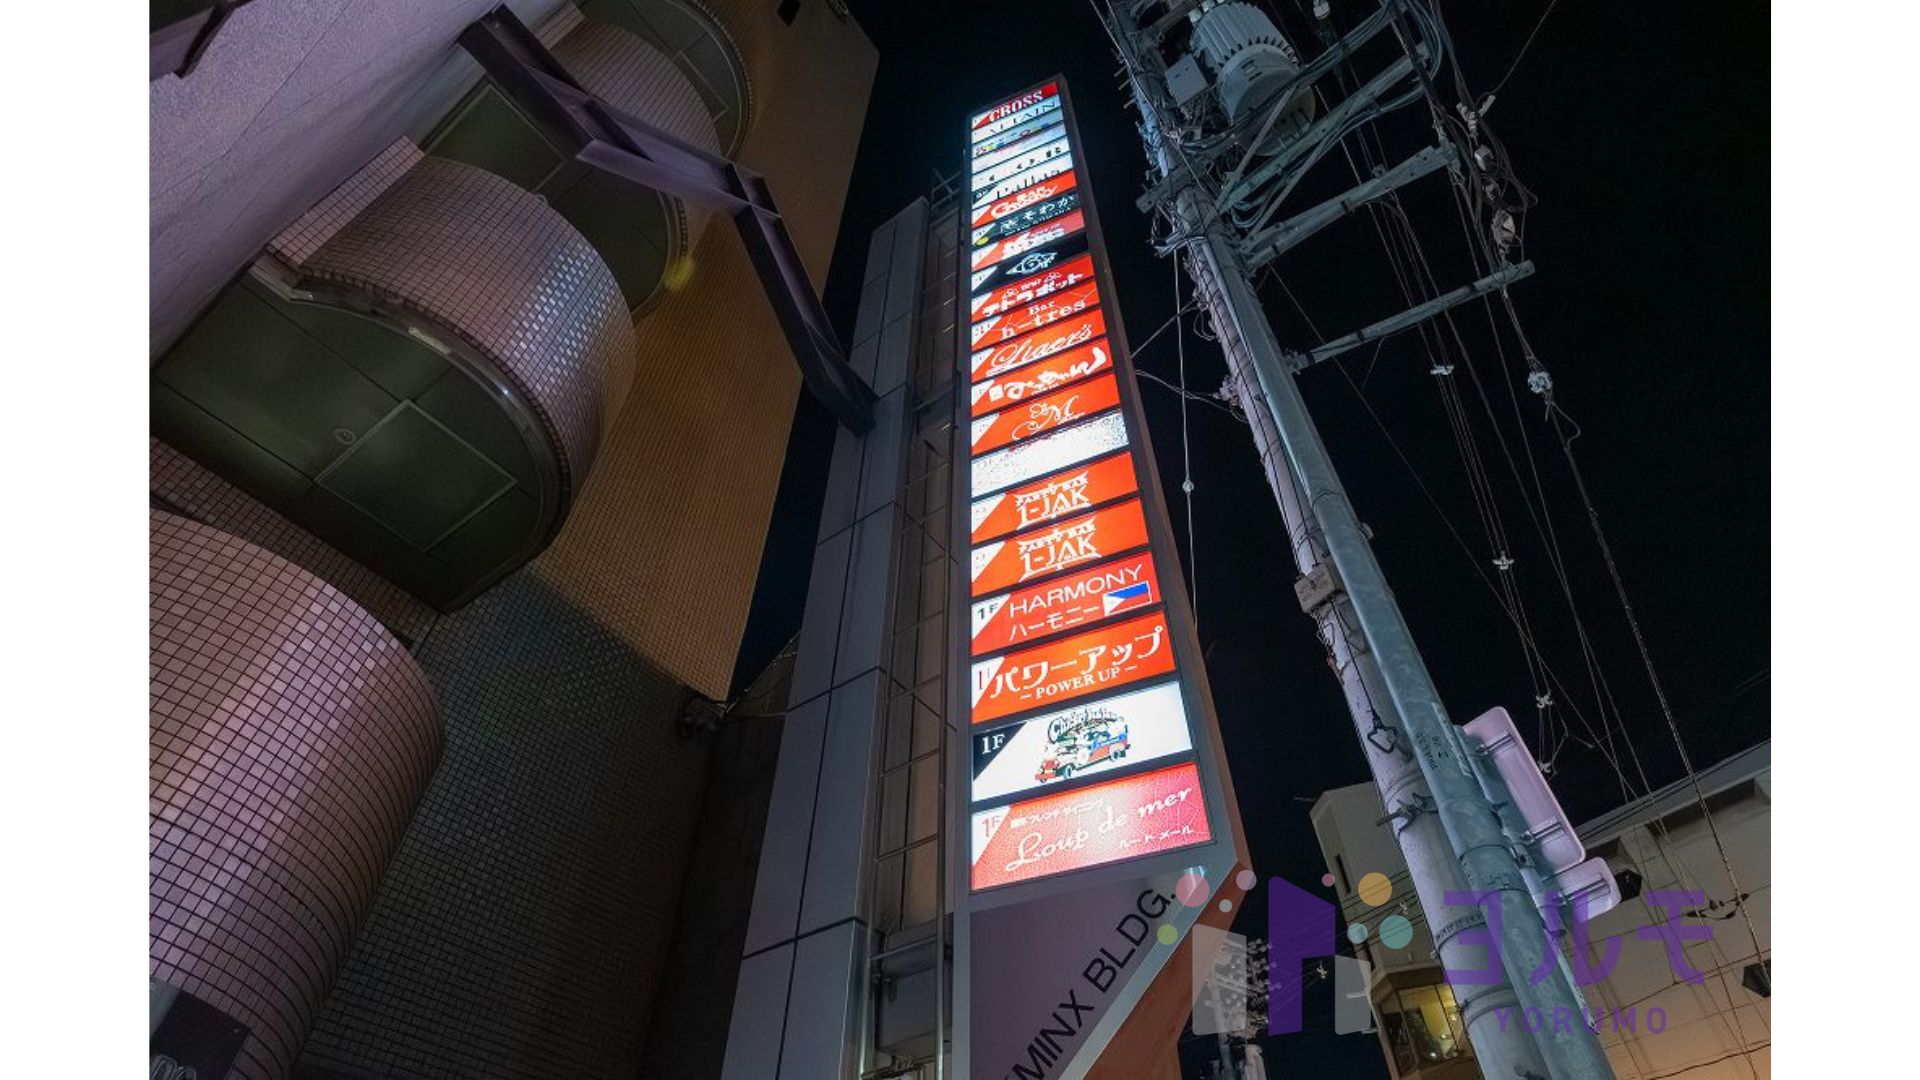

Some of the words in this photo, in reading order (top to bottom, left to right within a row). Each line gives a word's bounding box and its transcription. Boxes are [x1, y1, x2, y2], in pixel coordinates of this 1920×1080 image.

[989, 90, 1043, 122] CROSS
[1028, 301, 1055, 315] Bar
[1009, 563, 1143, 618] HARMONY
[977, 602, 999, 620] 1F
[1009, 605, 1100, 641] ハーモニー
[989, 625, 1164, 699] パワーアップ
[1035, 673, 1096, 699] POWER
[1098, 666, 1121, 682] UP
[981, 734, 1005, 755] 1F
[981, 815, 1001, 839] 1F
[1005, 831, 1089, 872] Loup
[1098, 806, 1128, 833] de
[1137, 787, 1192, 818] mer
[1003, 988, 1095, 1080] MINX
[1082, 889, 1176, 993] BLDG.
